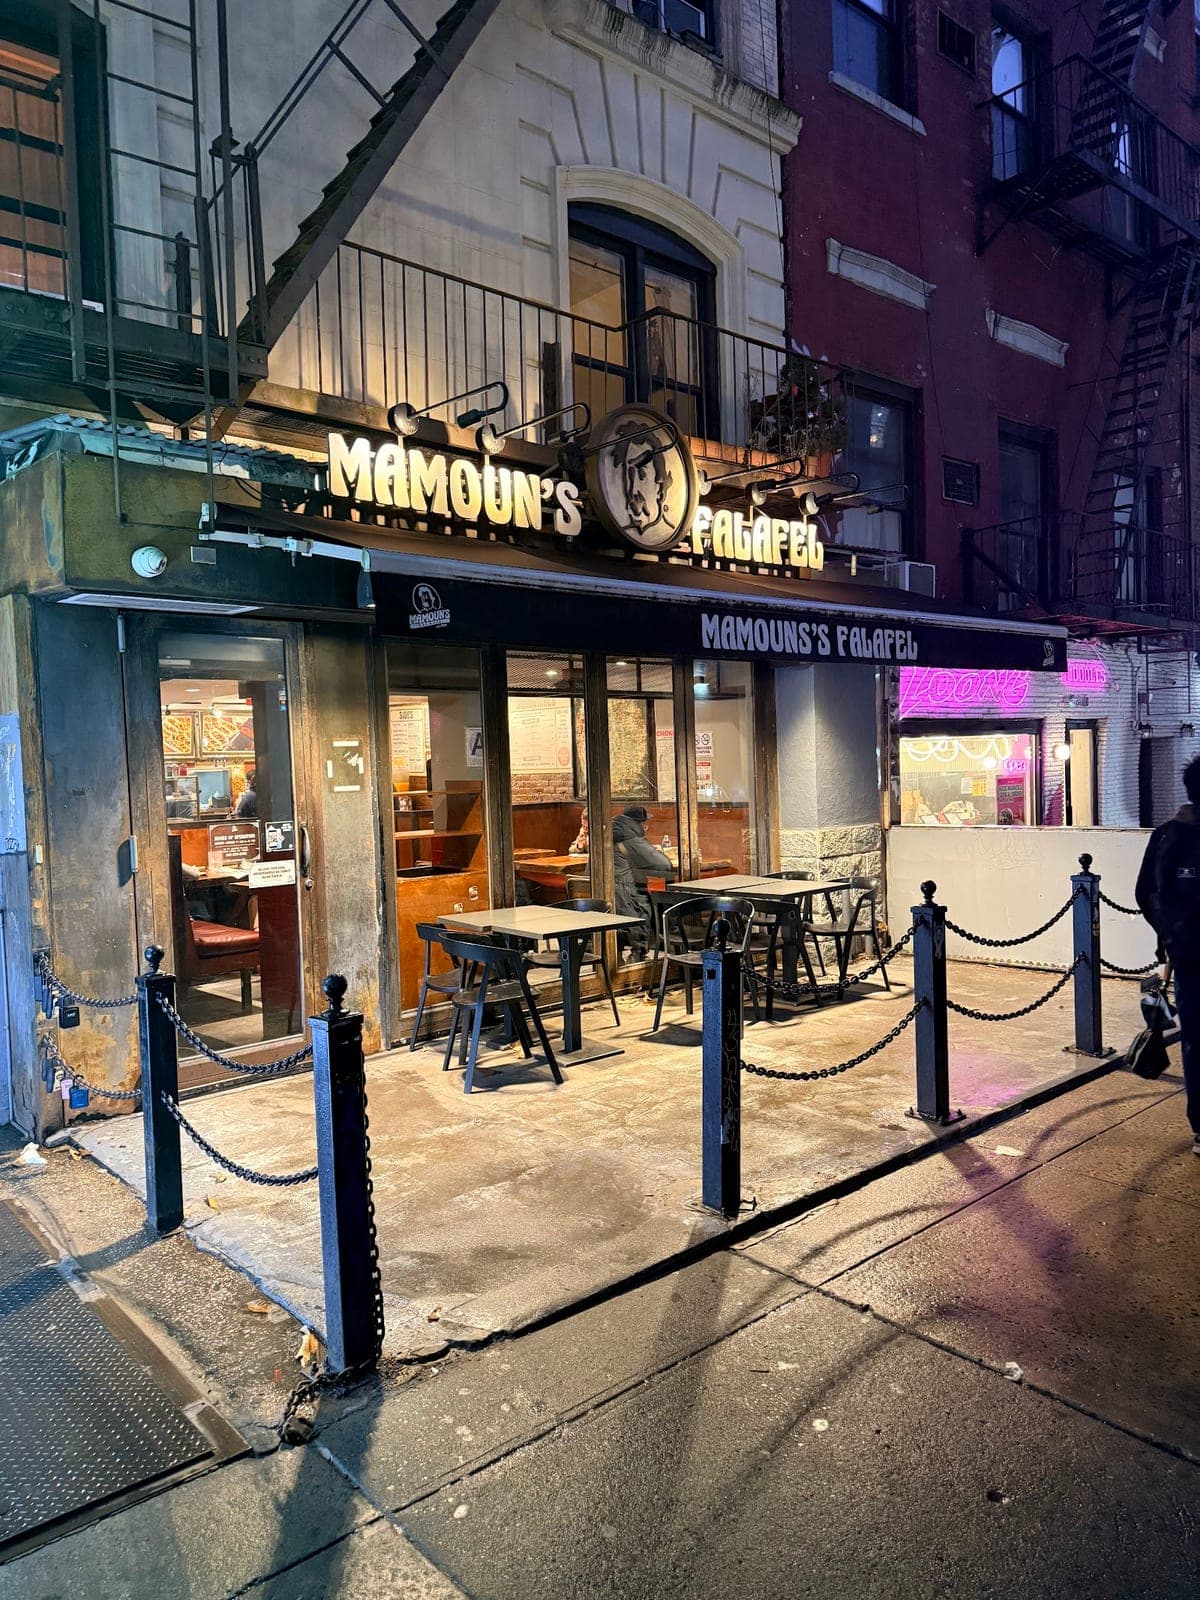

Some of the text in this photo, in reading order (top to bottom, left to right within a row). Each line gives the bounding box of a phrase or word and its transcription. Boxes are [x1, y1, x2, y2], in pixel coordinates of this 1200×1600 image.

[327, 432, 824, 570] MAMOUN'S FALAFEL
[701, 613, 918, 660] MAMOUNS'S FALAFEL
[471, 732, 484, 755] A
